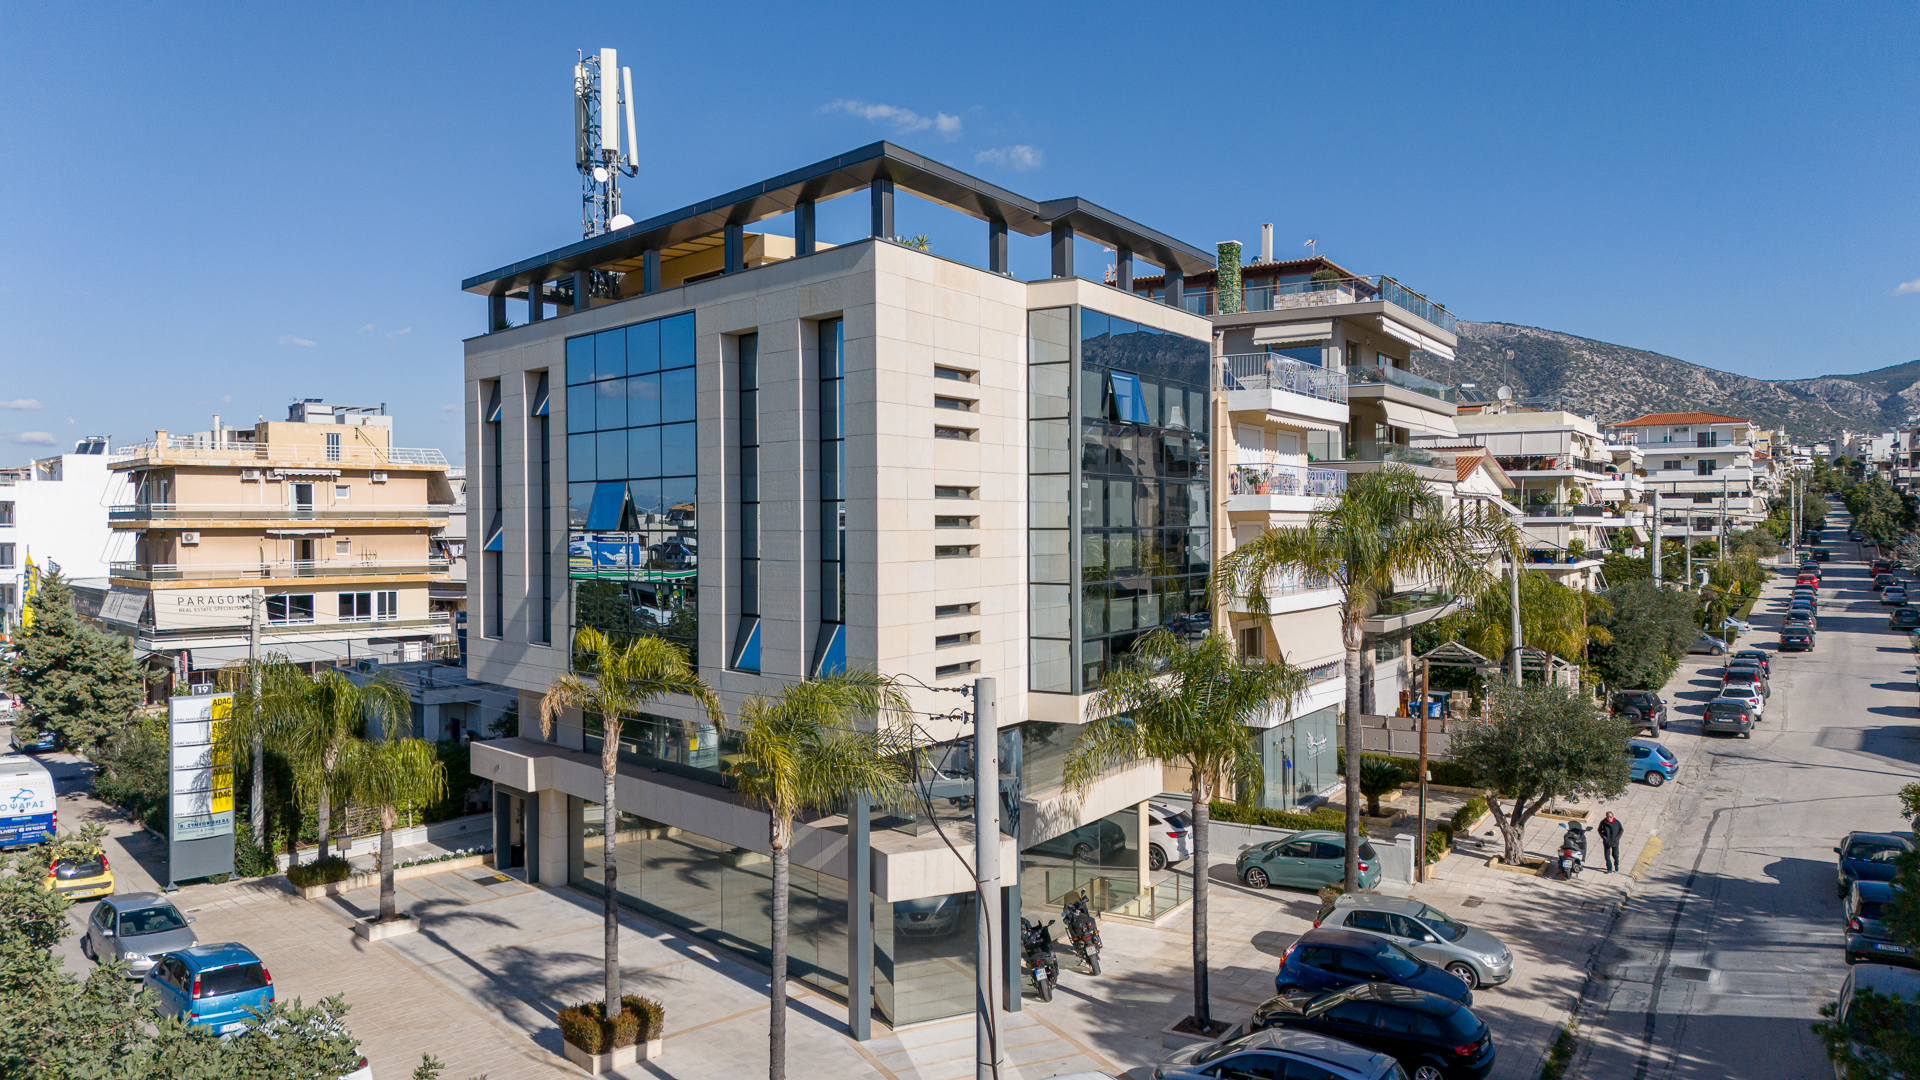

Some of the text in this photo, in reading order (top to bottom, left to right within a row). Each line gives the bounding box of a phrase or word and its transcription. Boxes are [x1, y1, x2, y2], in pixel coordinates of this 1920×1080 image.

[177, 595, 245, 606] PARAGON
[198, 686, 208, 694] 19
[212, 698, 232, 706] ADAC
[213, 767, 232, 776] ADAC
[213, 790, 232, 800] ADAC
[10, 800, 44, 810] ΨΑΡΑΣ
